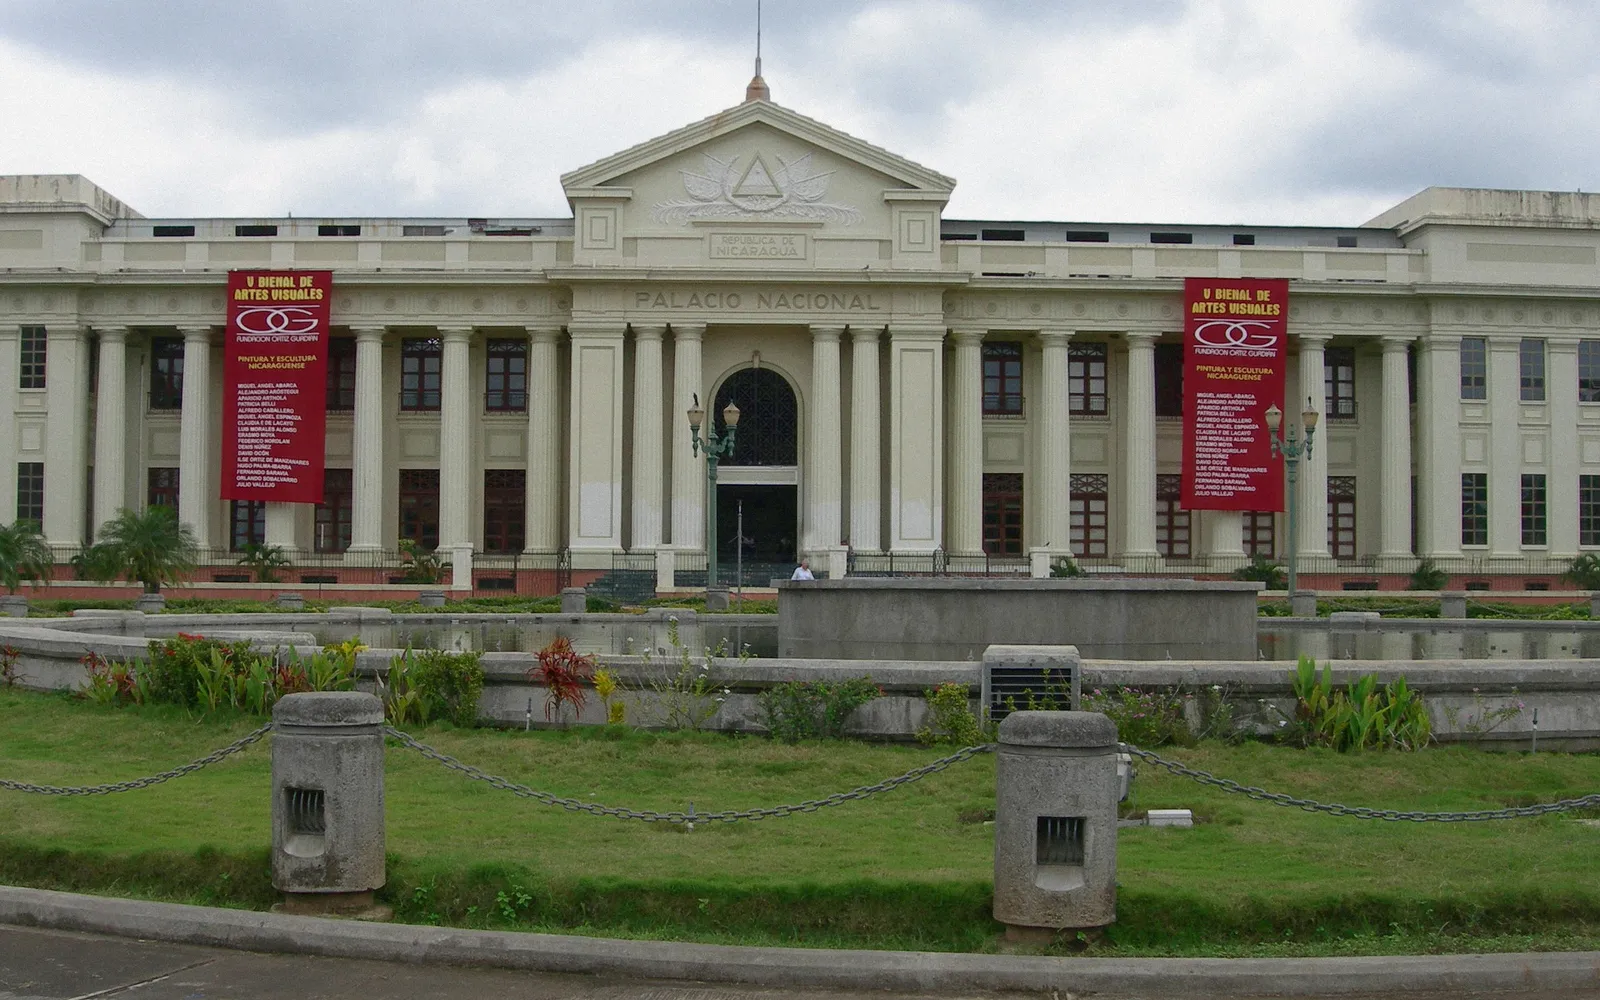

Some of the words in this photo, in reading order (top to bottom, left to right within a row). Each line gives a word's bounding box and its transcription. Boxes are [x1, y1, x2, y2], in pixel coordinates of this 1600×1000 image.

[722, 236, 776, 245] REPUBLICA
[782, 237, 795, 245] DE
[716, 246, 798, 256] NICARAGUA
[247, 276, 254, 287] V
[258, 277, 295, 287] BIENAL
[300, 276, 313, 287] DE
[234, 289, 269, 300] ARTES
[272, 289, 323, 300] VISUALES
[1204, 289, 1210, 299] V
[1215, 289, 1251, 300] BIENAL
[1257, 290, 1270, 301] DE
[635, 292, 741, 309] PALACIO
[757, 293, 880, 310] NACIONAL
[1192, 302, 1226, 313] ARTES
[1229, 303, 1280, 315] VISUALES
